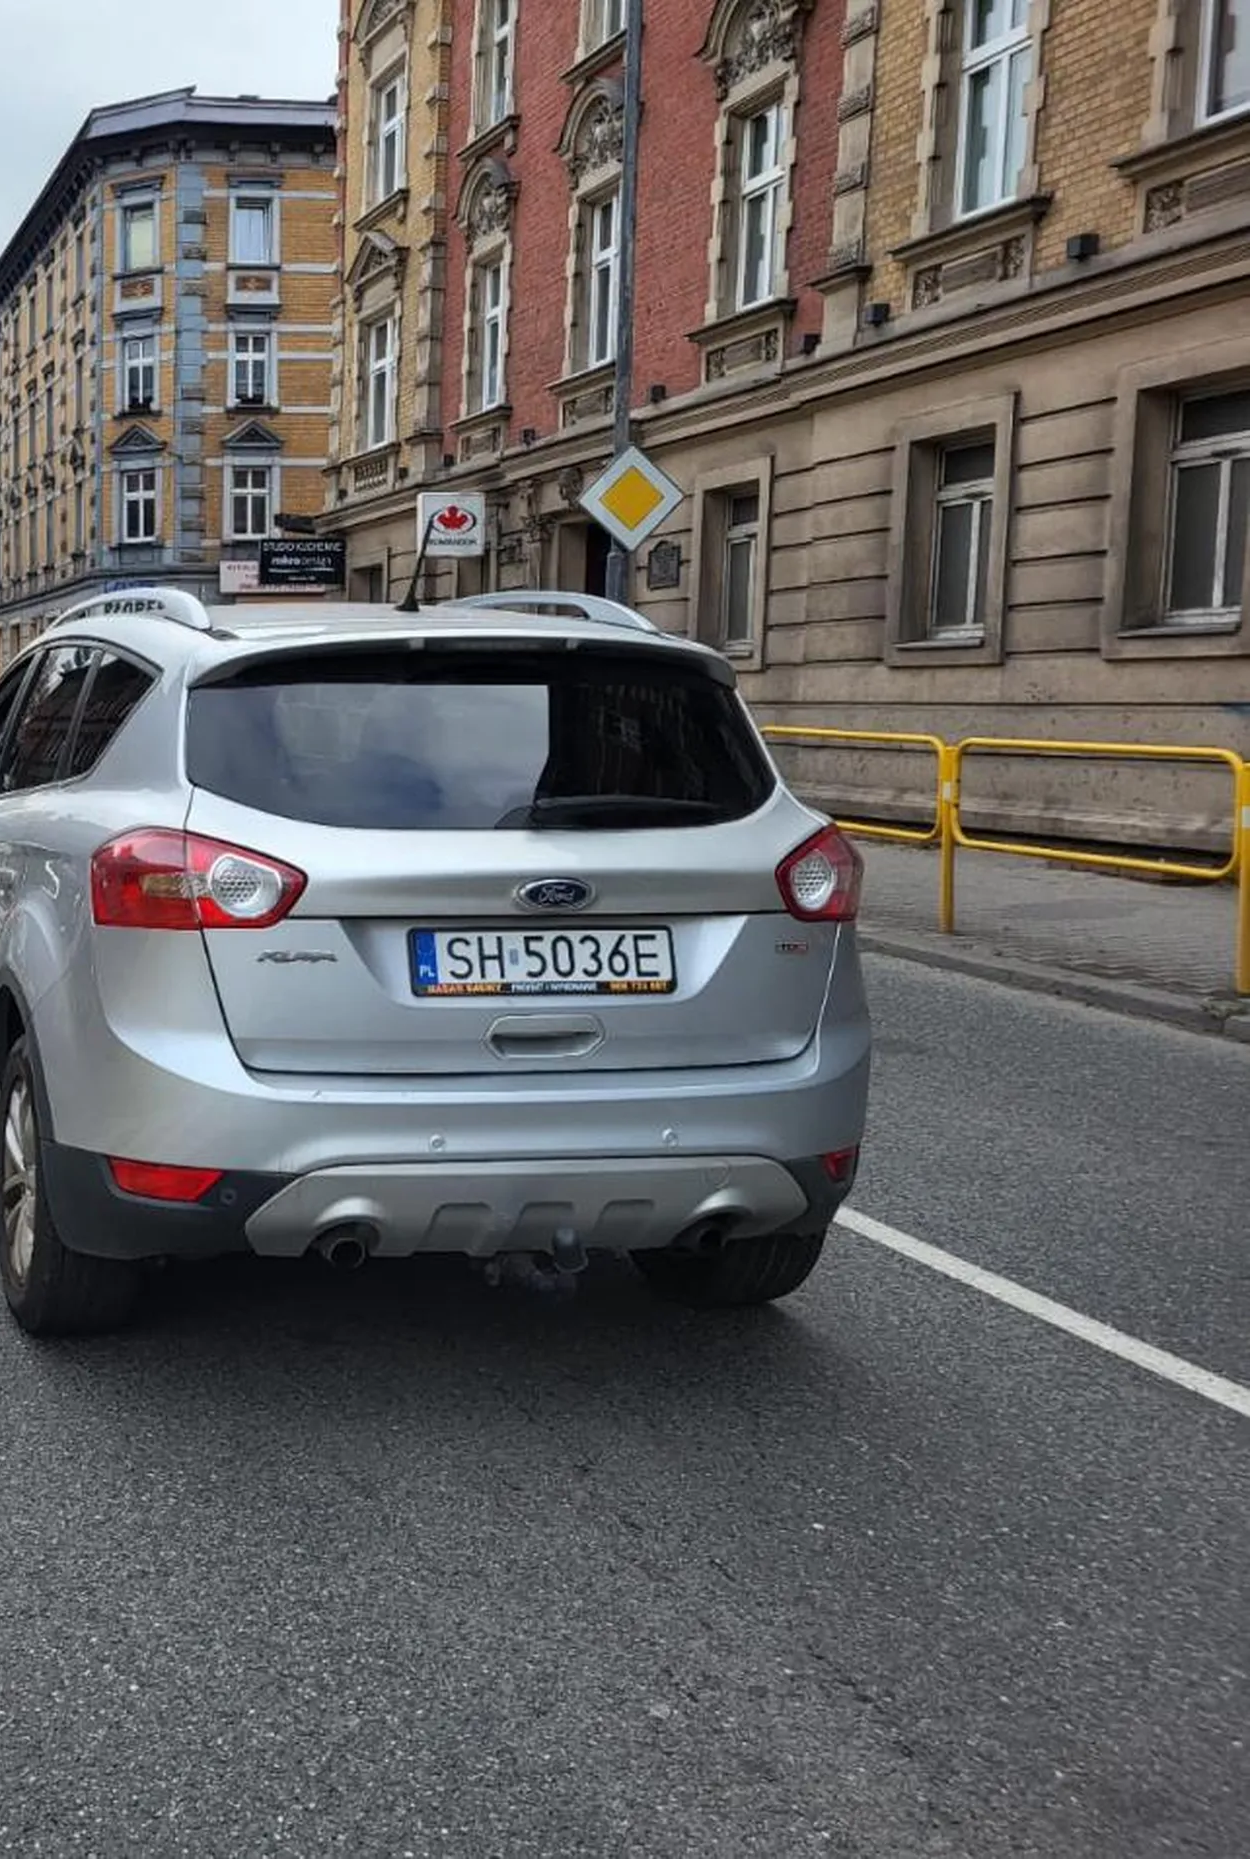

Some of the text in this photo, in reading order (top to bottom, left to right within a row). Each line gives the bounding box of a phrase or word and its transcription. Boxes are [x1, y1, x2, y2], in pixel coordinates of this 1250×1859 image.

[537, 885, 575, 904] Ford
[446, 933, 661, 980] SH 5036E
[419, 964, 435, 978] PL
